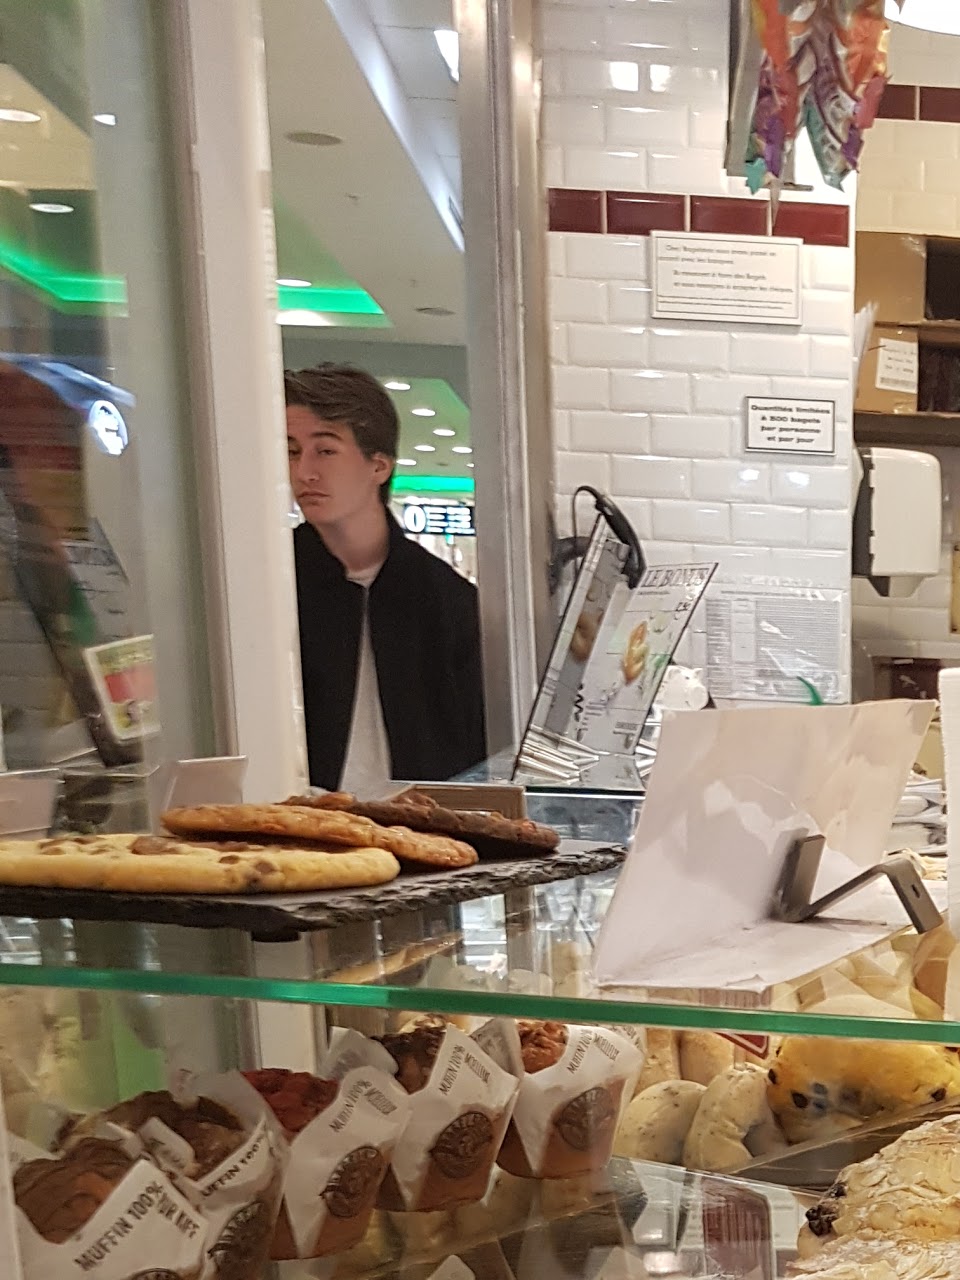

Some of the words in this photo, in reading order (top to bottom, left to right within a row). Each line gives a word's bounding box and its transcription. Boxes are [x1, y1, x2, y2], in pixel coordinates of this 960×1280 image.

[201, 1164, 241, 1197] UFFIN
[73, 1217, 134, 1272] MUFFIN
[127, 1181, 163, 1221] 100%
